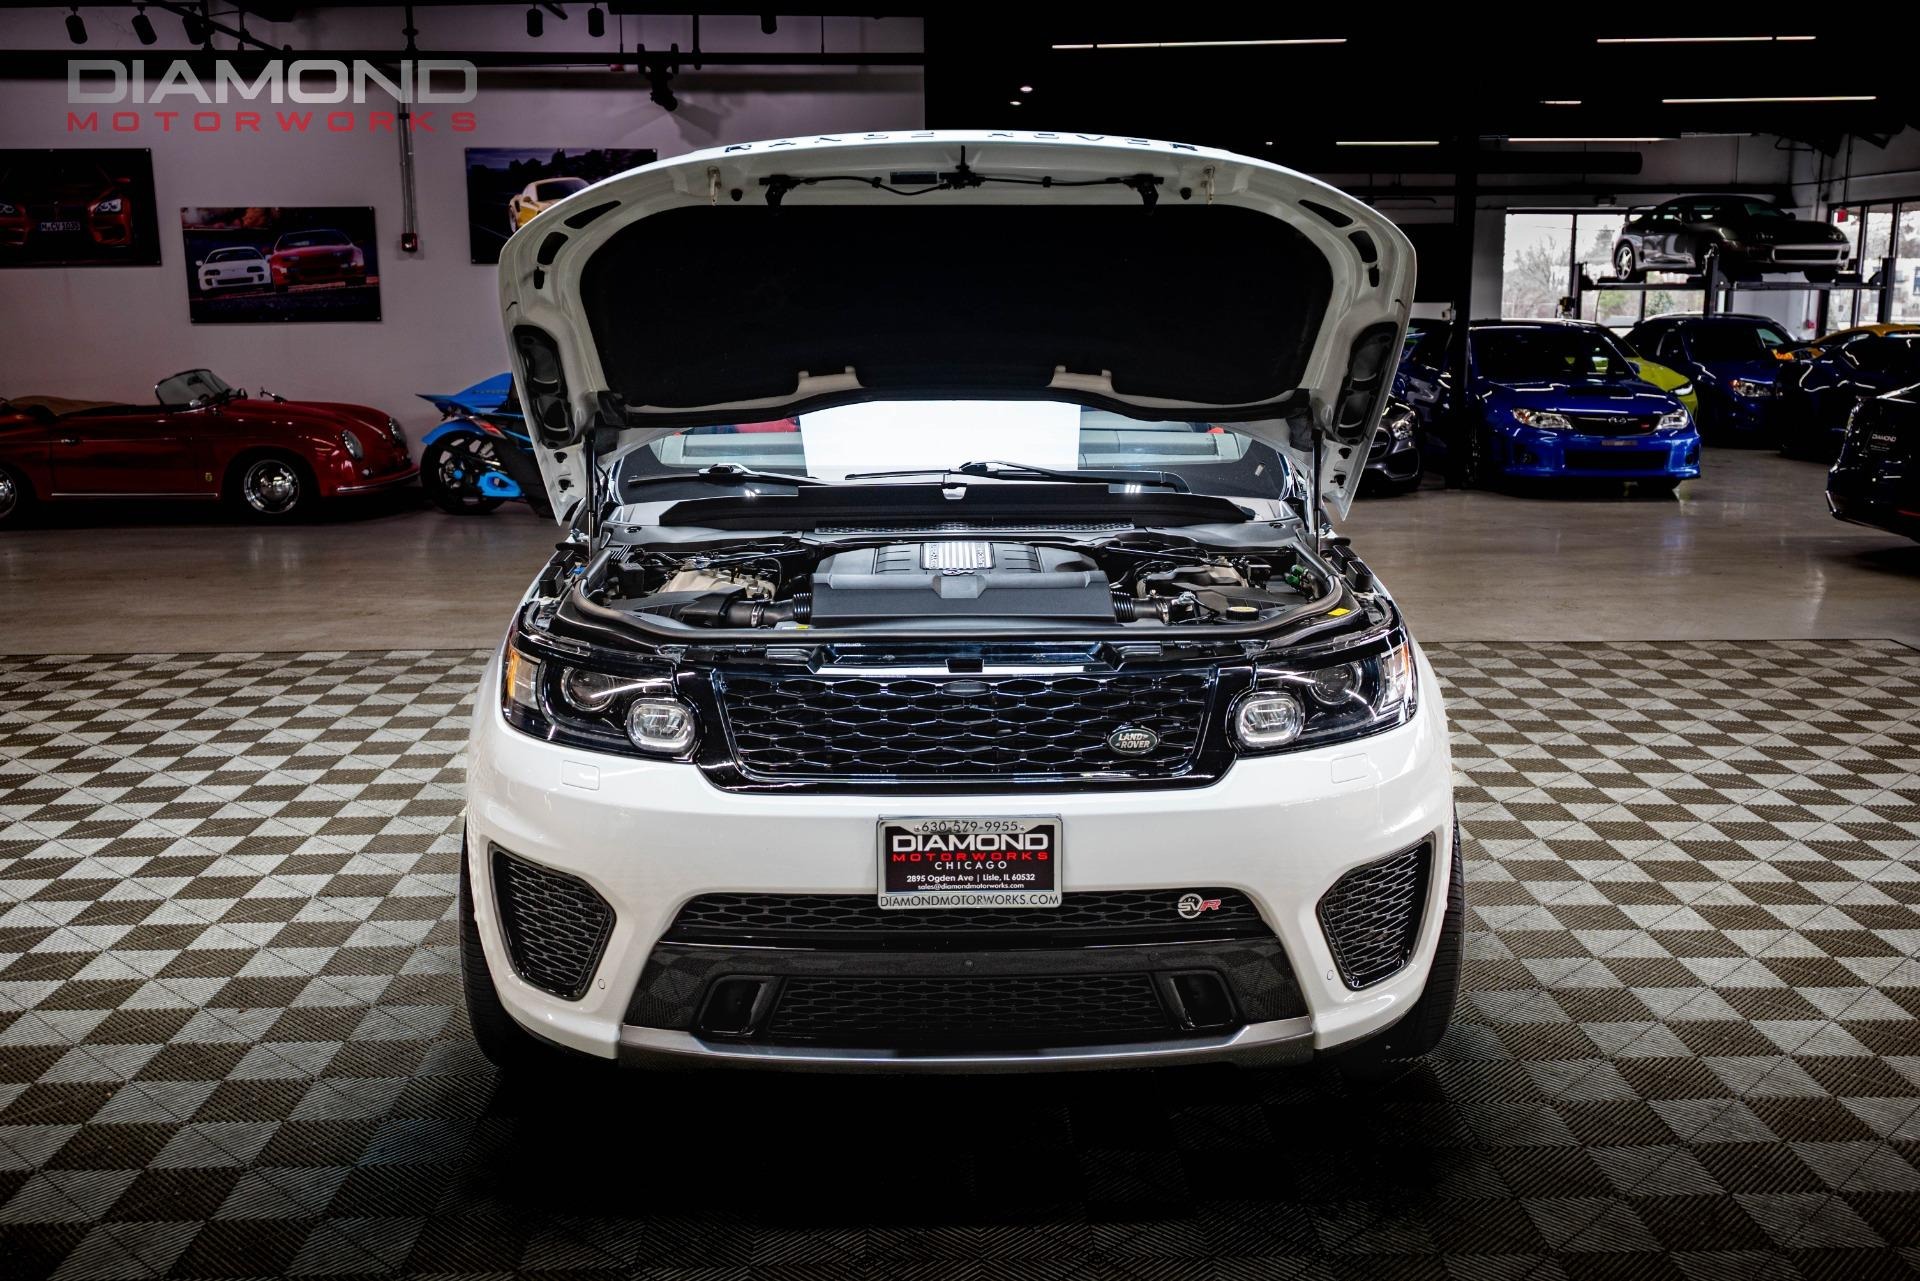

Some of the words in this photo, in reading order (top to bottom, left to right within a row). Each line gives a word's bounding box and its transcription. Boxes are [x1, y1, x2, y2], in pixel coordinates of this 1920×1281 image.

[1119, 733, 1142, 741] LAND
[1121, 740, 1150, 749] ROVER
[893, 833, 1049, 852] DIAMOND
[893, 852, 1048, 862] MOTORWORKS
[934, 861, 1007, 870] CHICAGO
[927, 875, 956, 883] Ogden
[957, 874, 974, 882] Ave
[1011, 873, 1035, 881] 60532
[918, 882, 1024, 891] sales@diamondmotorworks.com
[880, 894, 1059, 907] DIAMONDMOTORWORKS.COM
[1178, 893, 1222, 919] SVR
